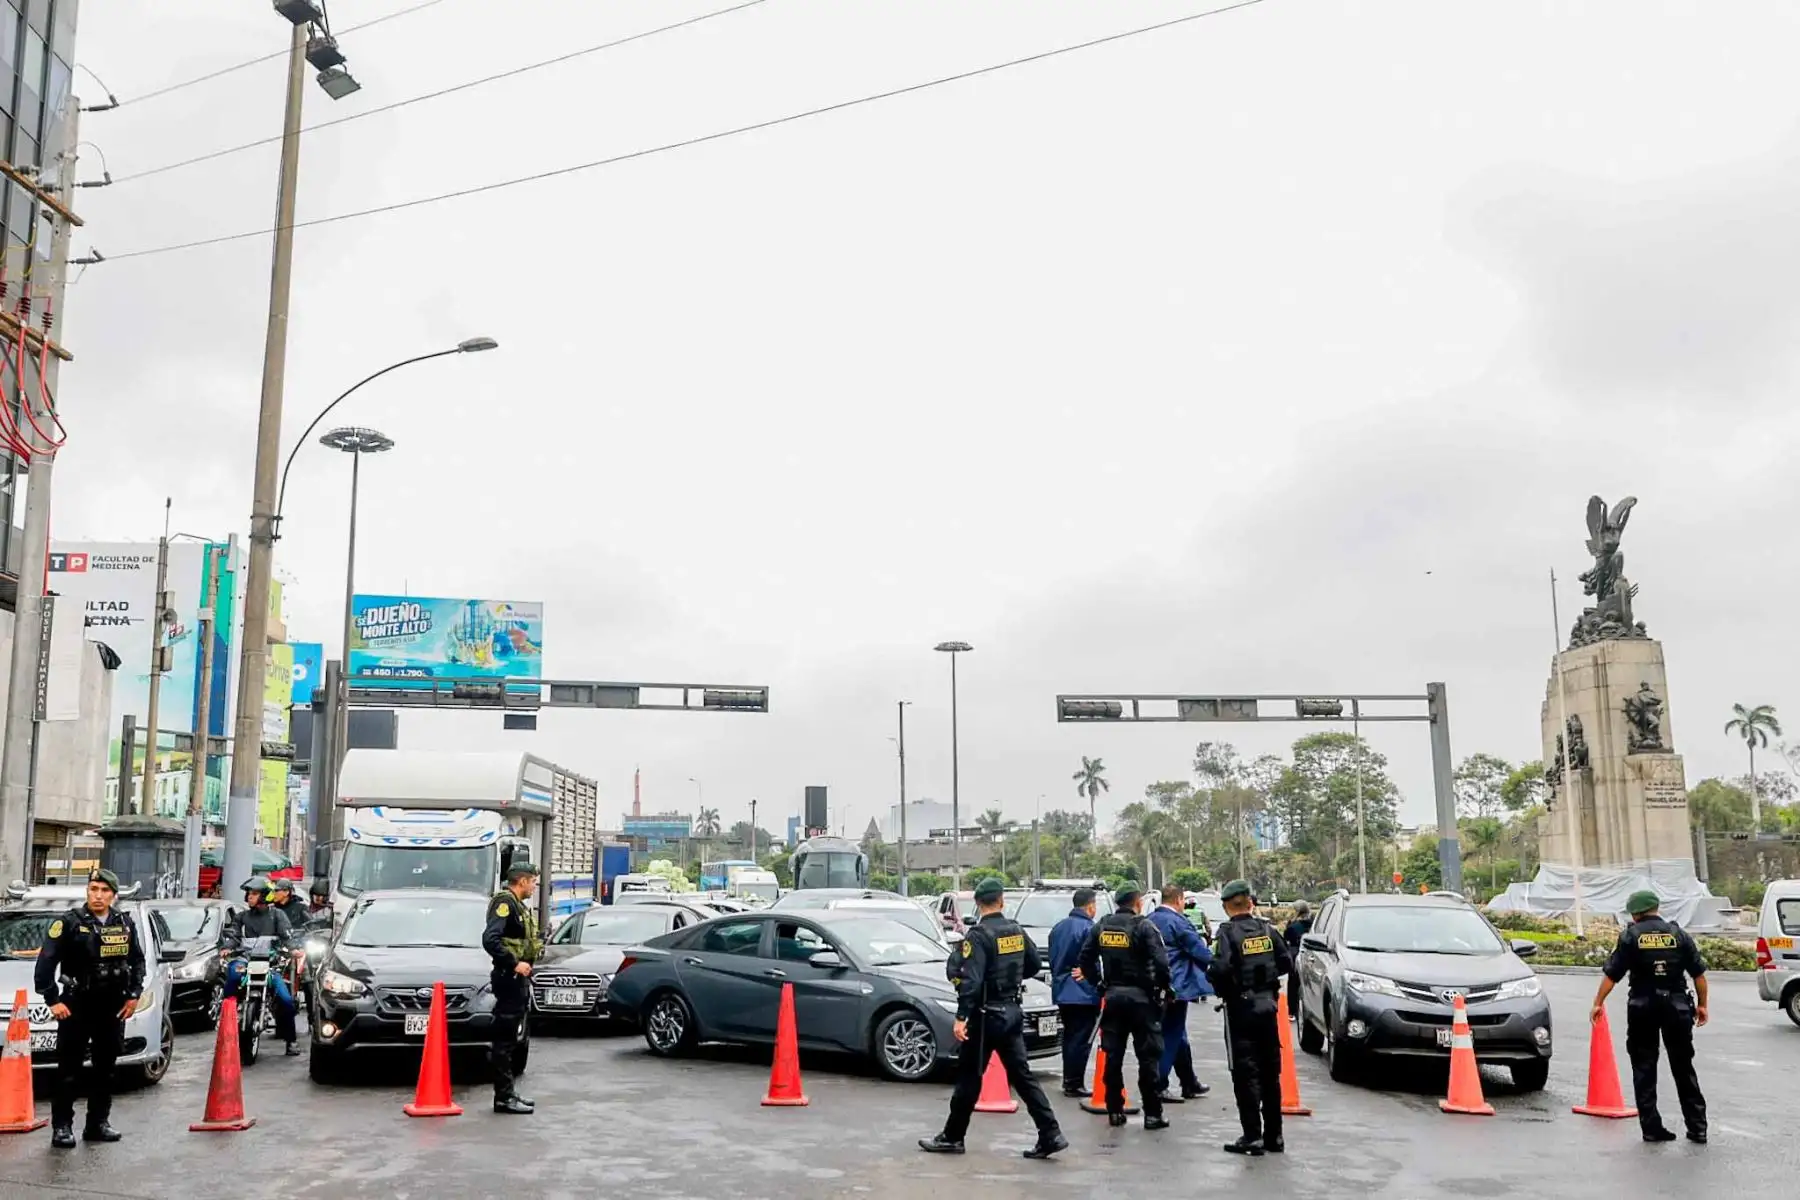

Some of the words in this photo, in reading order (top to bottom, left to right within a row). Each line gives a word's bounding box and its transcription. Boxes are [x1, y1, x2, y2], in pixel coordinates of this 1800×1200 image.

[92, 555, 140, 563] FACULTAD
[42, 603, 51, 640] POSTE
[367, 602, 421, 626] DUEÑO
[362, 623, 400, 638] MONTE
[401, 620, 427, 634] ALTO
[38, 651, 47, 712] TEMPORAL
[1102, 934, 1127, 945] POLICIA
